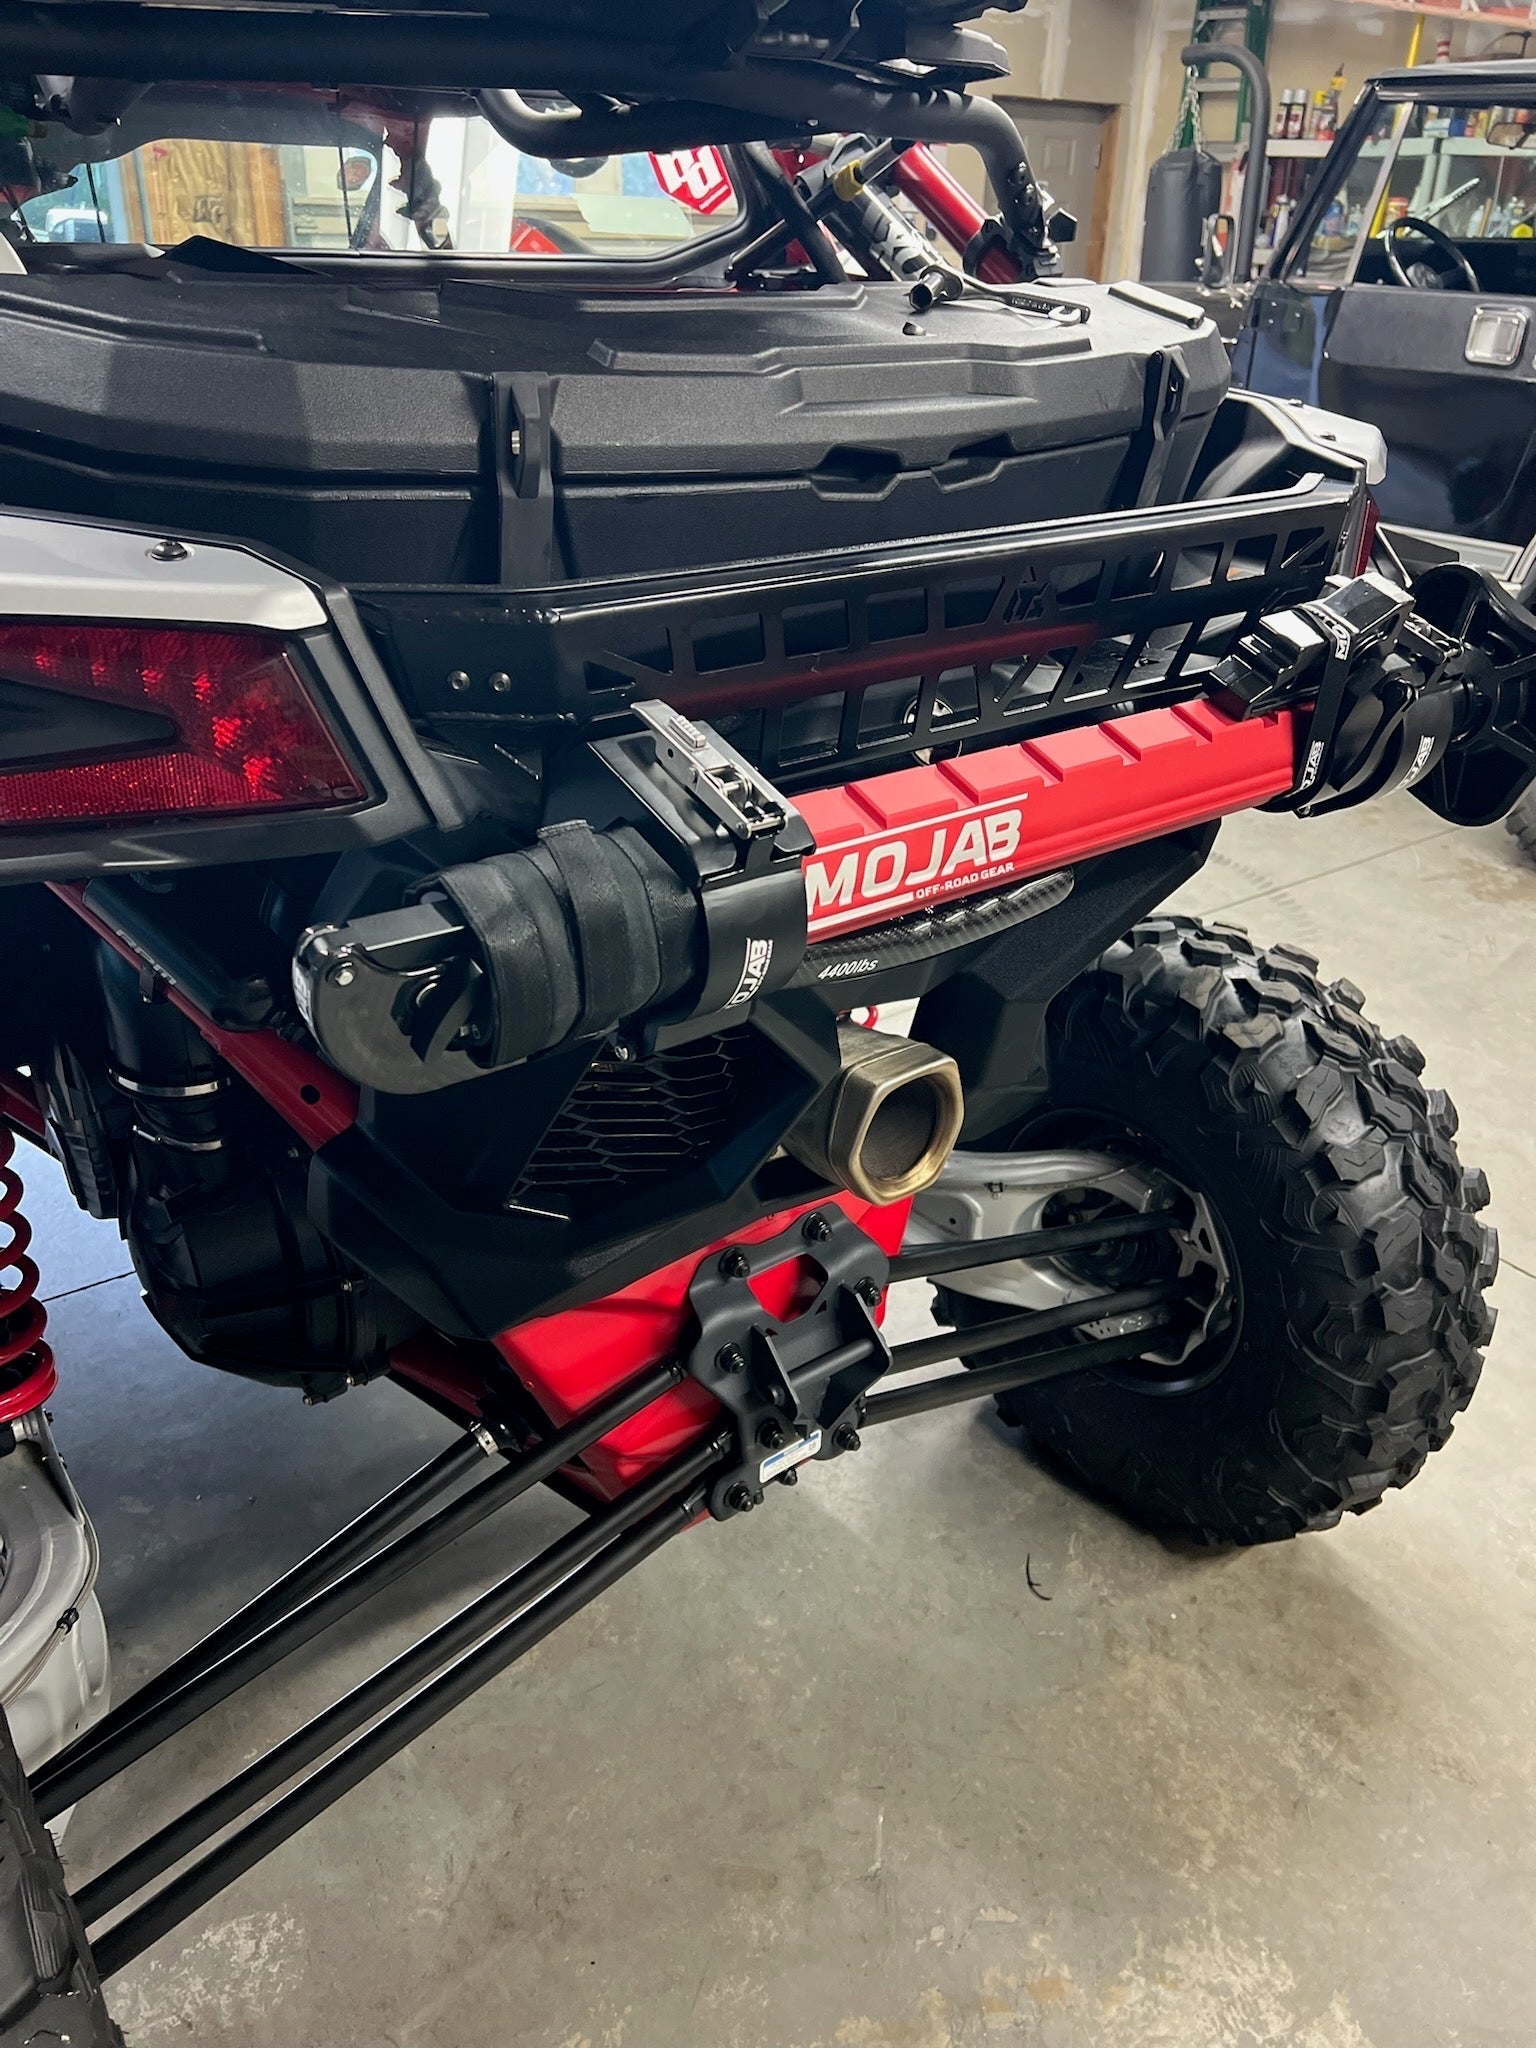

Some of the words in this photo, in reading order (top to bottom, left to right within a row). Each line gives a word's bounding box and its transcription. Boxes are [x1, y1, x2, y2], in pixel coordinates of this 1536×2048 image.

[804, 808, 1022, 915] MOJAB
[916, 872, 979, 900] OFF-ROAD
[981, 862, 1015, 881] GEAR
[730, 939, 768, 1004] OJAB
[818, 958, 878, 981] 4400lbs
